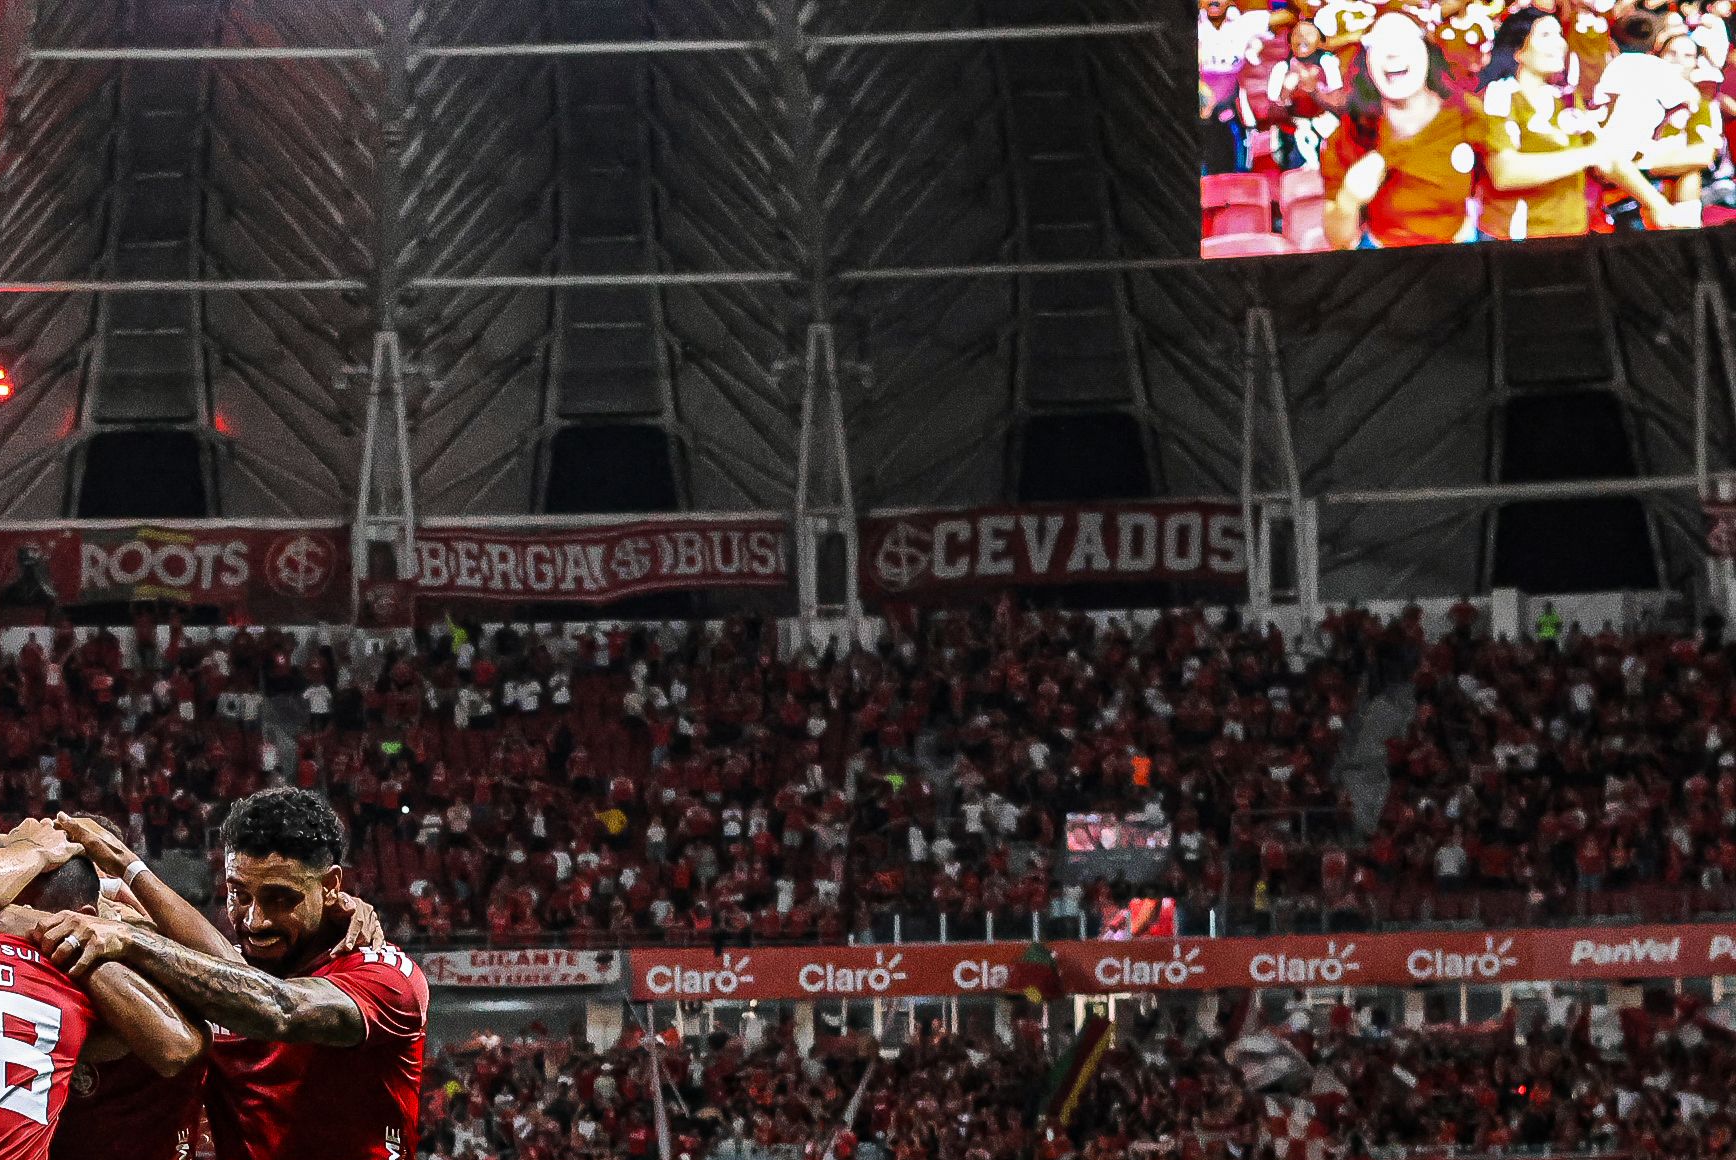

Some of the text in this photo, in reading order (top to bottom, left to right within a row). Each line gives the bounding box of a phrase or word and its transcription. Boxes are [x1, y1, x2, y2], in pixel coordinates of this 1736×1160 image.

[930, 509, 1247, 578] CEVADOS
[80, 539, 250, 590] ROOTS
[645, 958, 739, 993] Claro
[798, 957, 893, 992] Claro
[952, 957, 1008, 991] Cla
[1094, 952, 1188, 986] Claro
[1249, 949, 1344, 983] Claro
[1406, 946, 1501, 979] Claro
